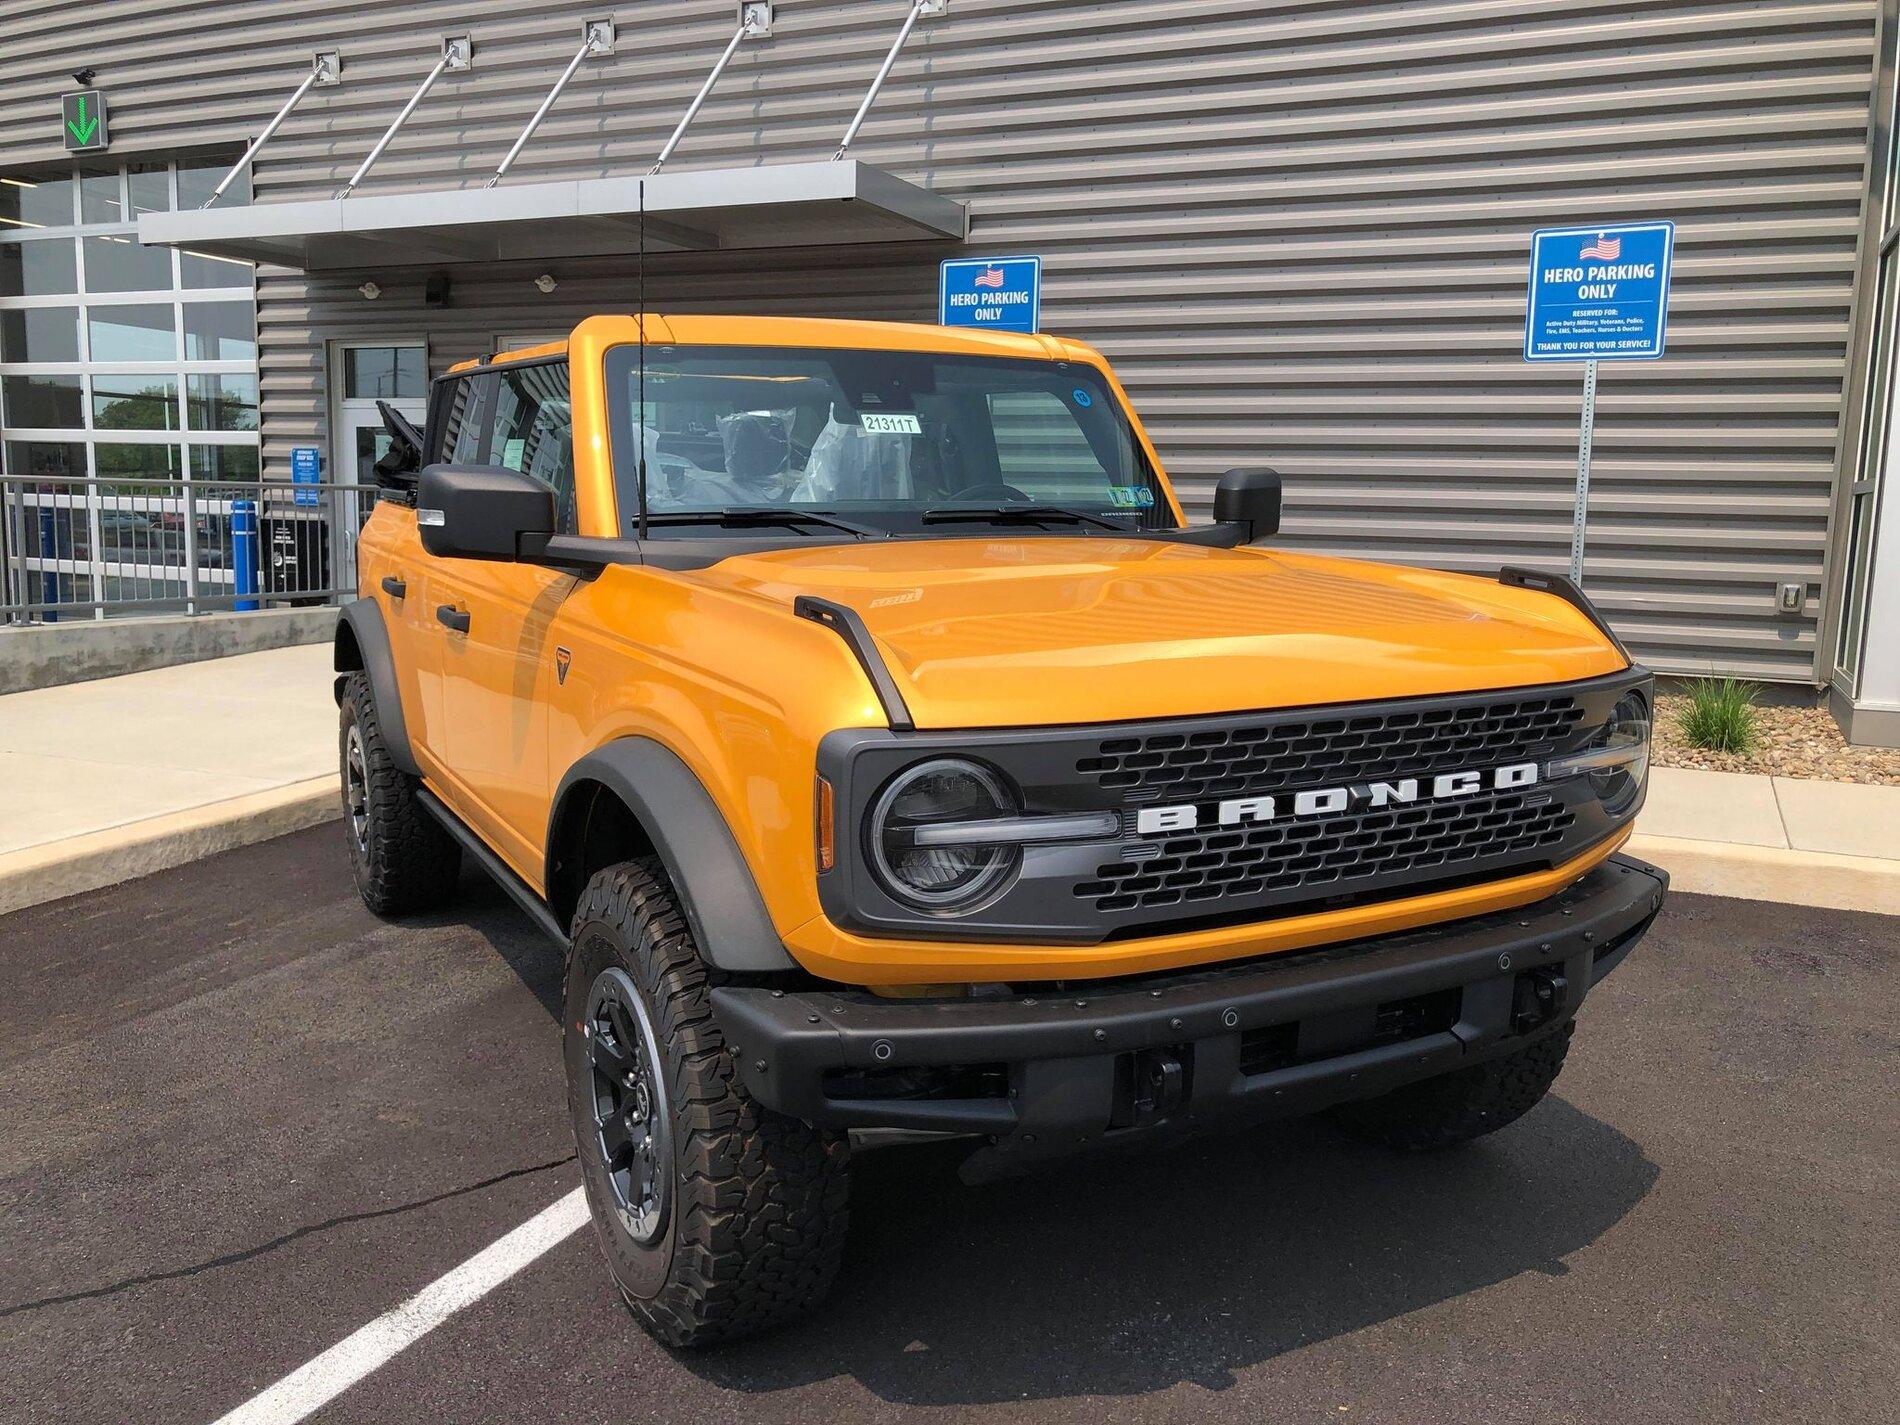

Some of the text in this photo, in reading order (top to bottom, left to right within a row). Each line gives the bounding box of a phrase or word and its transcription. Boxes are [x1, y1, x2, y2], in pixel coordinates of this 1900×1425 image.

[1544, 263, 1655, 283] HERO PARKING
[950, 291, 1029, 306] HERO PARKING
[1578, 284, 1617, 299] ONLY
[974, 307, 1003, 320] ONLY
[1537, 340, 1651, 350] THANK YOU FOR YOUR SERVICE!
[866, 416, 913, 432] 21311T
[1138, 762, 1538, 834] BRONCO
